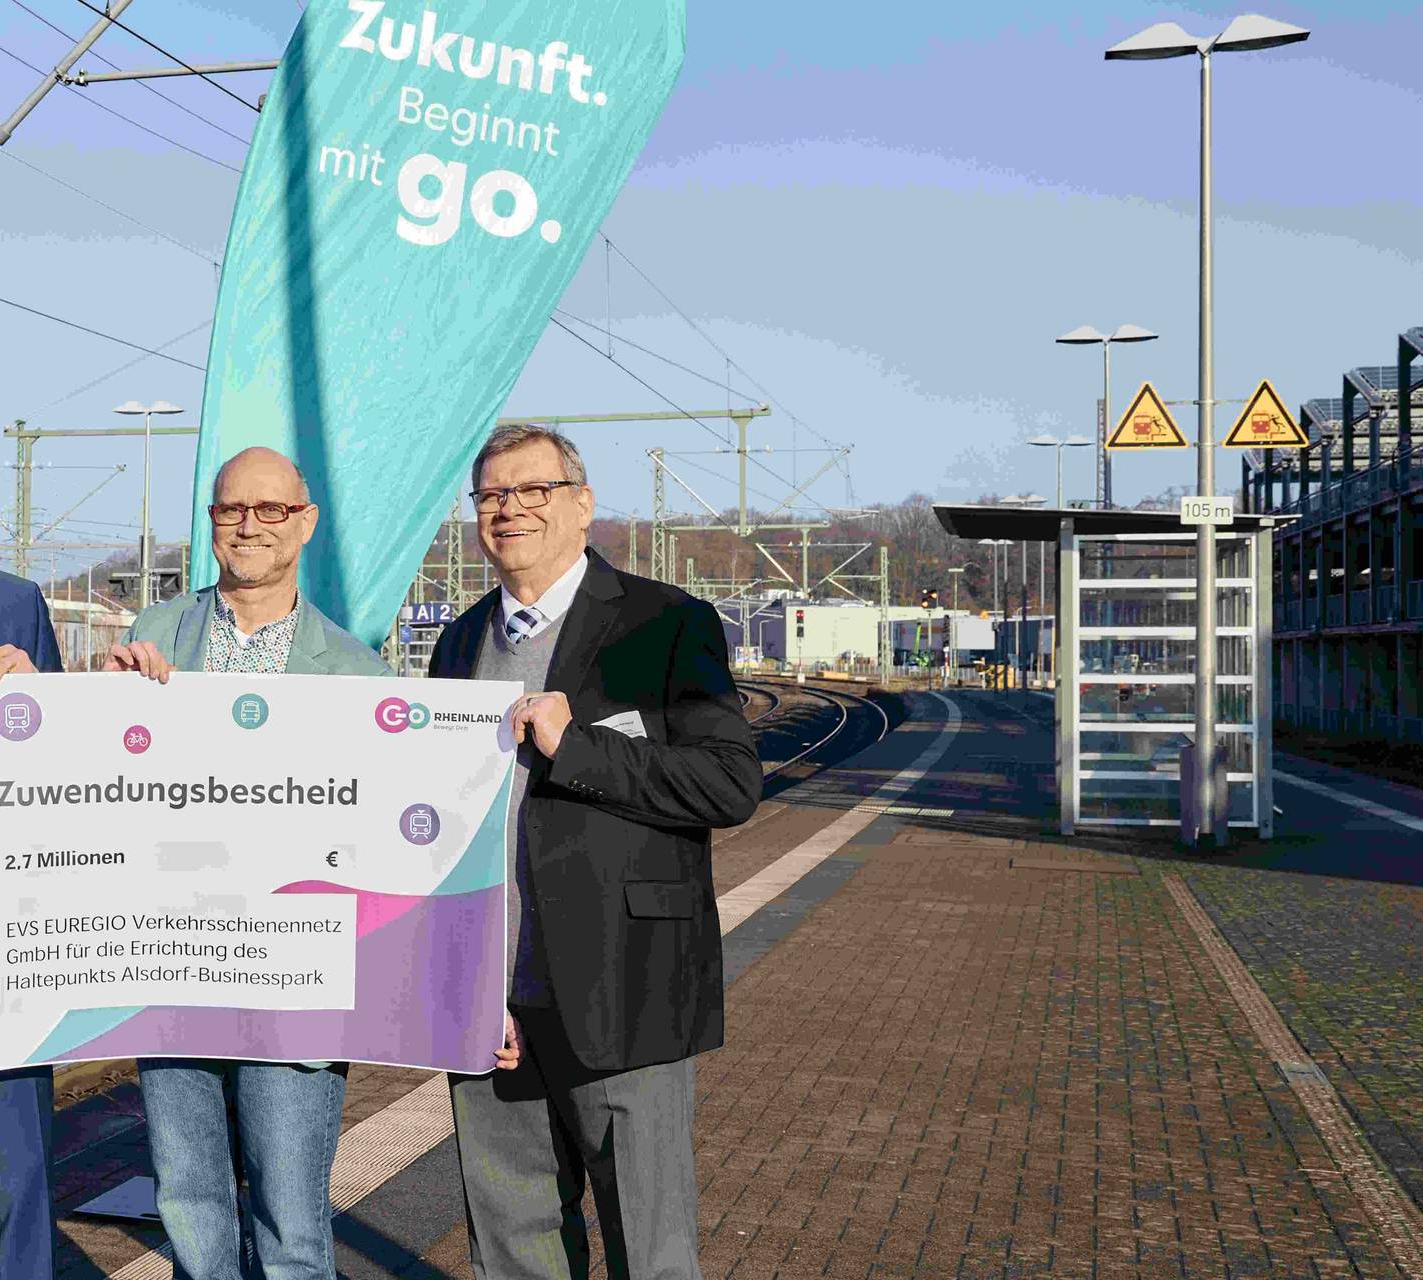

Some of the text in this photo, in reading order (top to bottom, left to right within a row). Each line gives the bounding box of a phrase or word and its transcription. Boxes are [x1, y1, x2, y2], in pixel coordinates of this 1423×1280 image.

[338, 0, 607, 107] Zukunft.
[397, 85, 560, 157] Beginnt
[318, 143, 562, 246] mit go.
[1184, 503, 1231, 518] 105 m
[417, 604, 451, 620] A 2
[434, 712, 502, 724] RHEINLAND
[36, 849, 126, 869] Millionen
[325, 850, 339, 868] €
[6, 914, 343, 938] EVS EUREGIO Verkehrsschienennetz
[6, 940, 268, 964] GmbH für die Errichtung des
[6, 966, 324, 991] Haltepunkts Alsdorf-Businesspark
